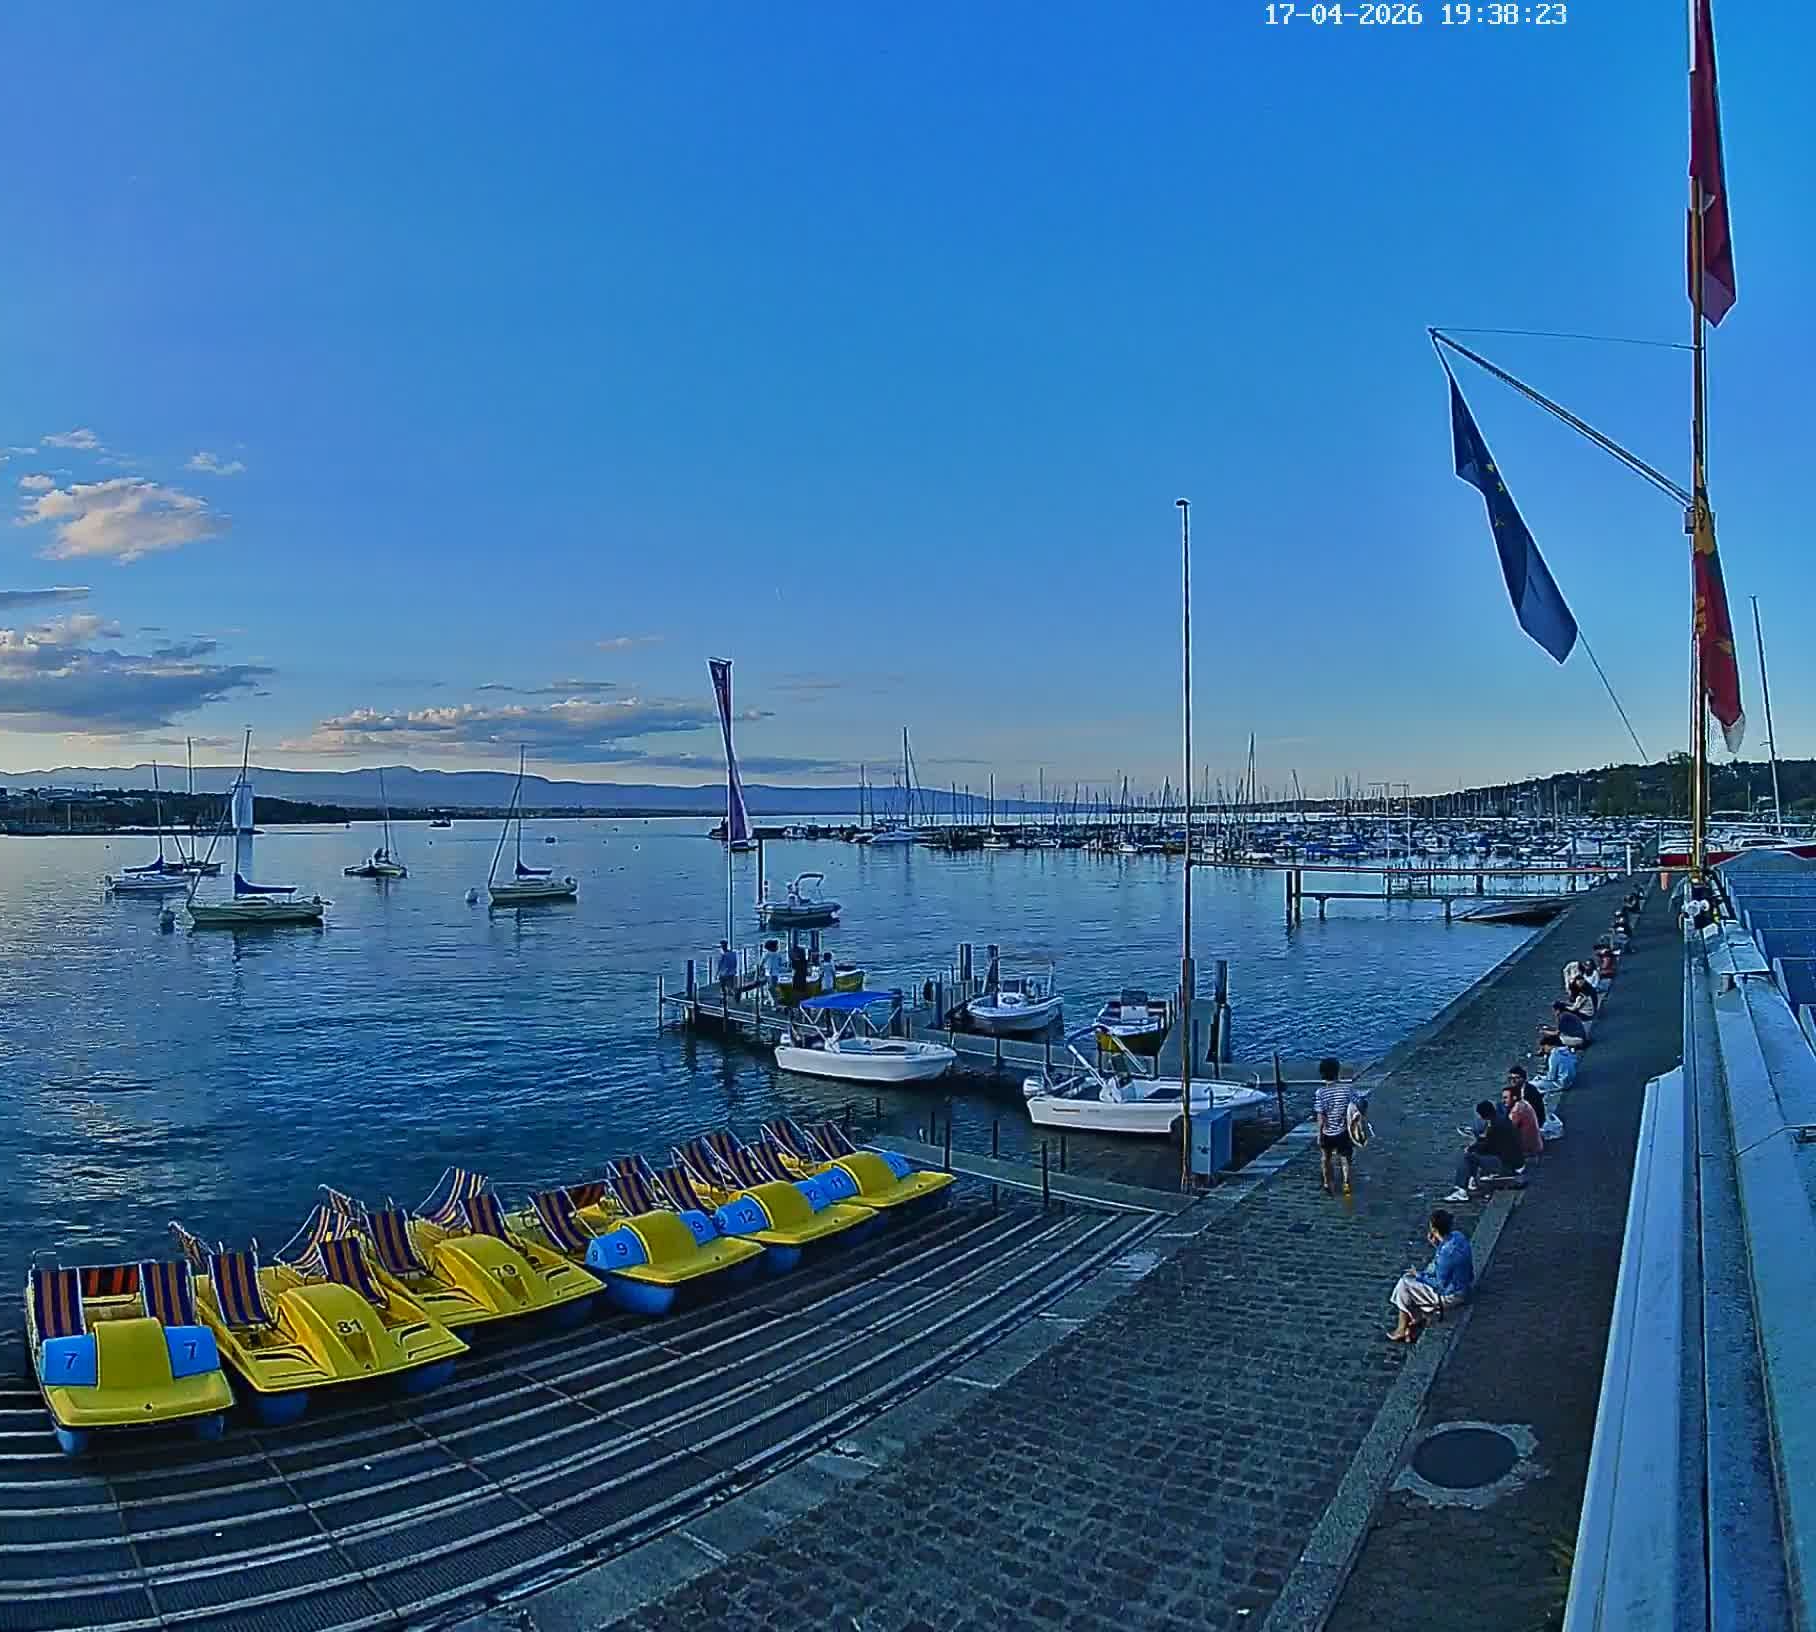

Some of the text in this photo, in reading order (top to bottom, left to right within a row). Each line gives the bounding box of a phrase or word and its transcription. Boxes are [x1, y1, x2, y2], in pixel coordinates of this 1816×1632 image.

[737, 1209, 756, 1223] 12
[692, 1220, 704, 1233] 9
[616, 1242, 628, 1256] 9
[490, 1264, 516, 1277] 79
[338, 1319, 362, 1334] 81
[184, 1341, 199, 1360] 7
[64, 1352, 77, 1370] 7
